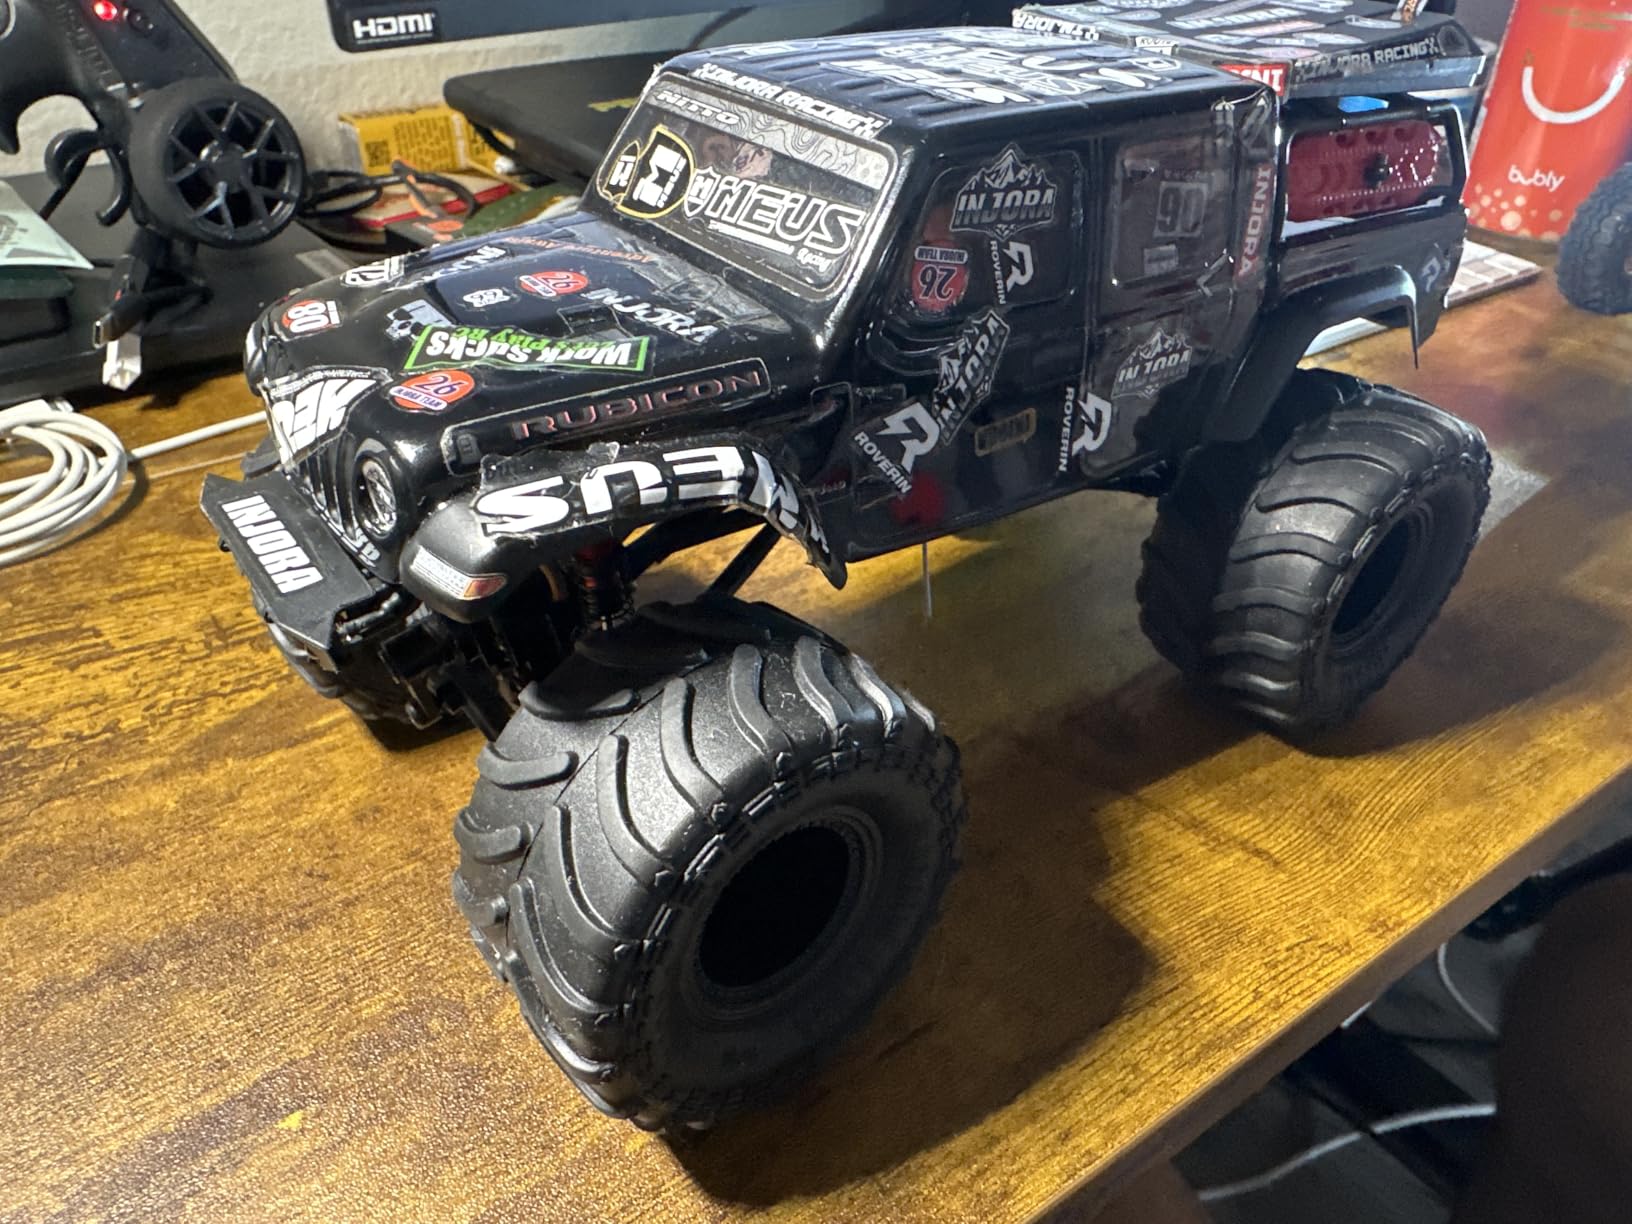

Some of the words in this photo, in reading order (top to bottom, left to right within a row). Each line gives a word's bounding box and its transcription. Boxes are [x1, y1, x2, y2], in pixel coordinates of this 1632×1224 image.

[352, 13, 433, 39] HDMI
[1374, 40, 1427, 64] RACING
[657, 90, 740, 125] NITTO
[711, 67, 782, 99] INJORA
[776, 90, 860, 131] RACING
[1508, 164, 1565, 192] bubly
[704, 175, 866, 255] MEUS
[954, 188, 1055, 226] INJORA
[1239, 167, 1272, 276] INJORA
[538, 274, 581, 290] 26
[919, 264, 957, 302] 26
[990, 240, 1007, 305] ROVERIN
[455, 327, 490, 341] RC
[580, 287, 719, 344] INJORA
[426, 330, 533, 363] Sucks
[494, 328, 551, 351] Play
[536, 341, 633, 366] Work
[414, 374, 467, 397] 26
[512, 371, 761, 441] RUBICON
[1059, 386, 1075, 472] ROVERIN
[854, 431, 912, 494] ROVERIN
[221, 495, 324, 594] INJORA
